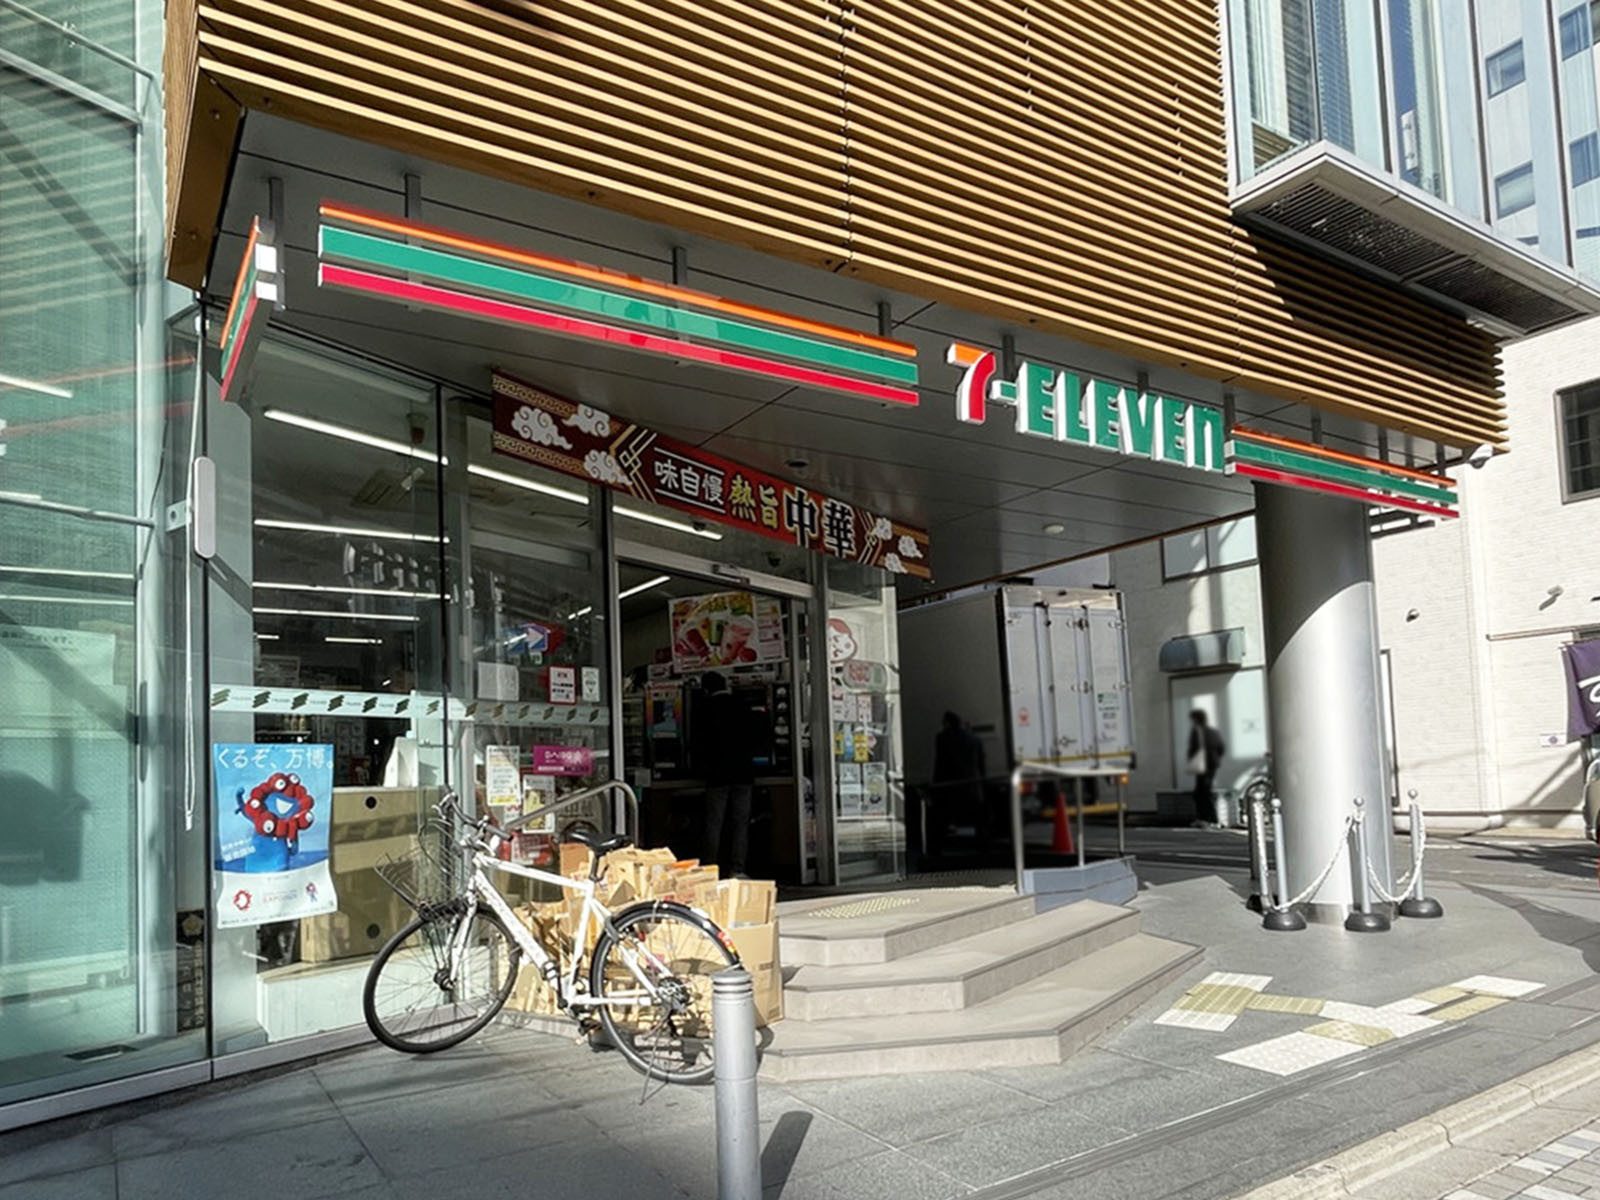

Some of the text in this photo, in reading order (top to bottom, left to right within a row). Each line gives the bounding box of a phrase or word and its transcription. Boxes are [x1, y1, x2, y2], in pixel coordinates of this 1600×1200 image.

[654, 459, 725, 506] 味自慢
[783, 485, 858, 560] 中華
[218, 747, 334, 769] くるぞ、万博。
